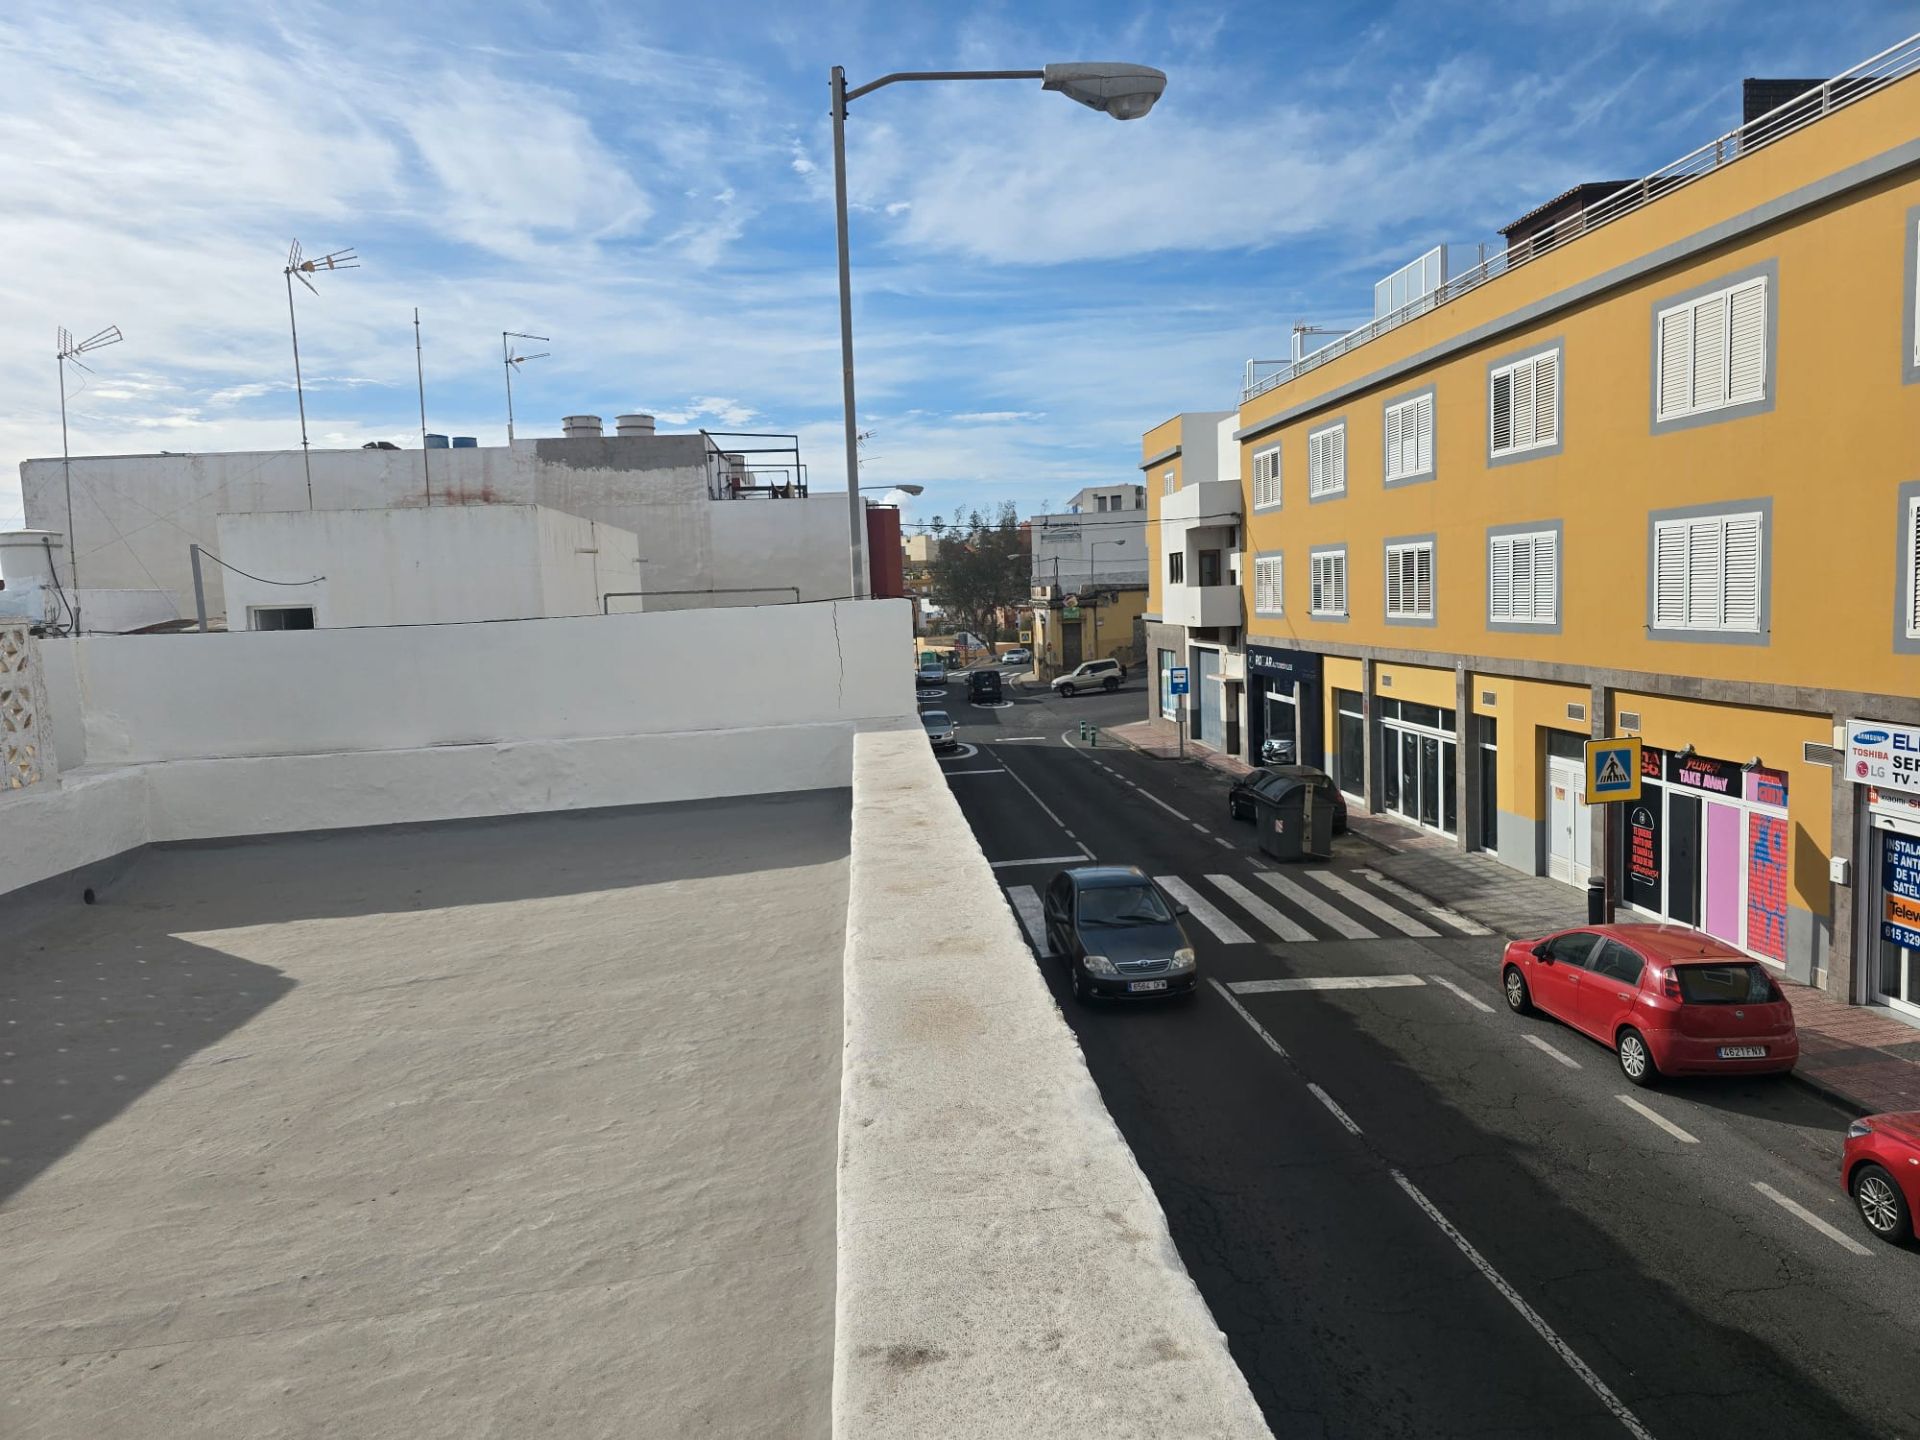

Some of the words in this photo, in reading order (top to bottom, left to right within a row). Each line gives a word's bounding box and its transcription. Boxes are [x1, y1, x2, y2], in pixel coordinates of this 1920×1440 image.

[1857, 733, 1886, 742] SAMSUNG
[1893, 733, 1920, 753] EL
[1852, 747, 1889, 760] TOSHIBA
[1871, 765, 1885, 778] LG
[1679, 768, 1701, 785] TAKE
[1702, 774, 1729, 792] AWAY
[1892, 772, 1910, 785] TV
[1887, 852, 1899, 865] DE
[1896, 867, 1908, 880] DE
[1885, 926, 1902, 941] 615
[1903, 930, 1920, 947] 329
[1724, 1047, 1745, 1057] 4621
